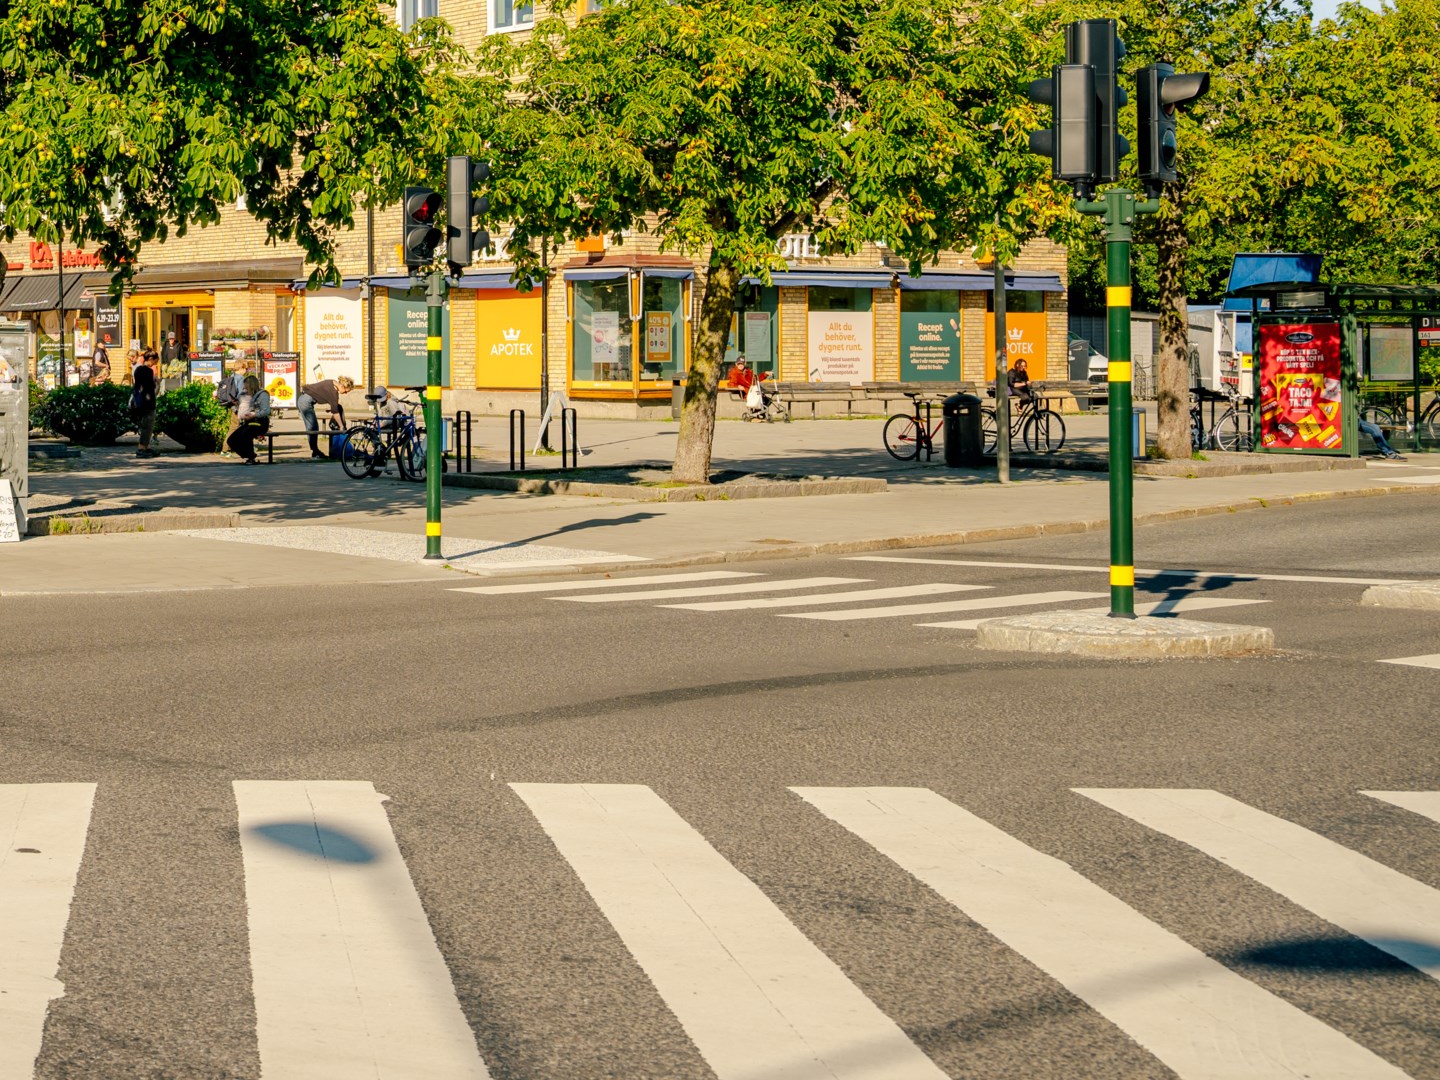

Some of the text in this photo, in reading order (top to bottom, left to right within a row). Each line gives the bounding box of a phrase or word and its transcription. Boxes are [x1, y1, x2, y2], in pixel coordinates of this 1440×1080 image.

[323, 313, 344, 321] Allt du
[406, 310, 429, 320] Recep
[320, 322, 348, 330] behöver,
[829, 322, 852, 331] Allt du
[1422, 317, 1430, 327] D
[918, 322, 944, 333] Recept
[314, 332, 337, 341] dygnet
[825, 332, 856, 341] behöver,
[918, 332, 943, 341] online.
[490, 343, 533, 356] APOTEK
[818, 342, 863, 353] dygnet runt.
[1006, 342, 1034, 354] POTEK
[277, 389, 293, 398] 30:-
[1288, 387, 1312, 398] TACO
